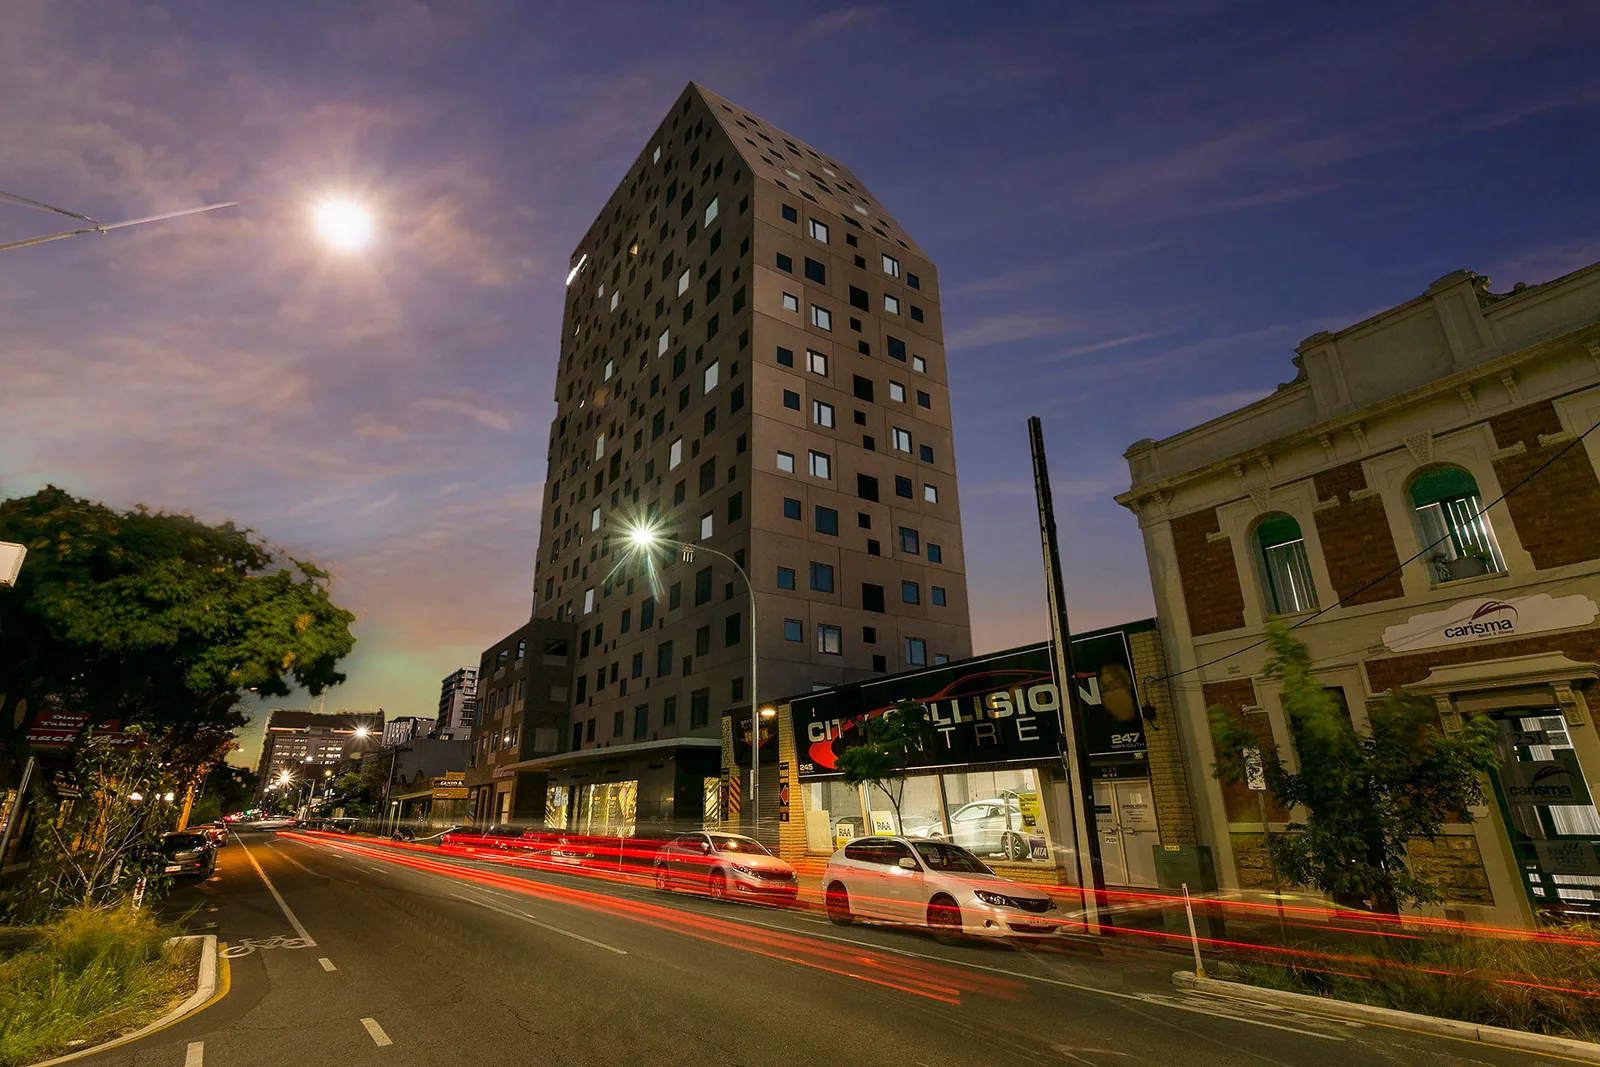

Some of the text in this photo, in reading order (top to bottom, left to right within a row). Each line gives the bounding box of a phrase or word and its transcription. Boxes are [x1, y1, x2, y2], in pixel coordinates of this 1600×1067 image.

[1445, 619, 1513, 638] carisma
[807, 675, 1102, 743] CITY CLLISION
[1111, 732, 1140, 744] 247
[1513, 731, 1543, 746] 251
[799, 763, 814, 771] 245
[876, 821, 892, 831] RAA
[838, 828, 852, 837] RAA
[1033, 846, 1048, 857] MTA
